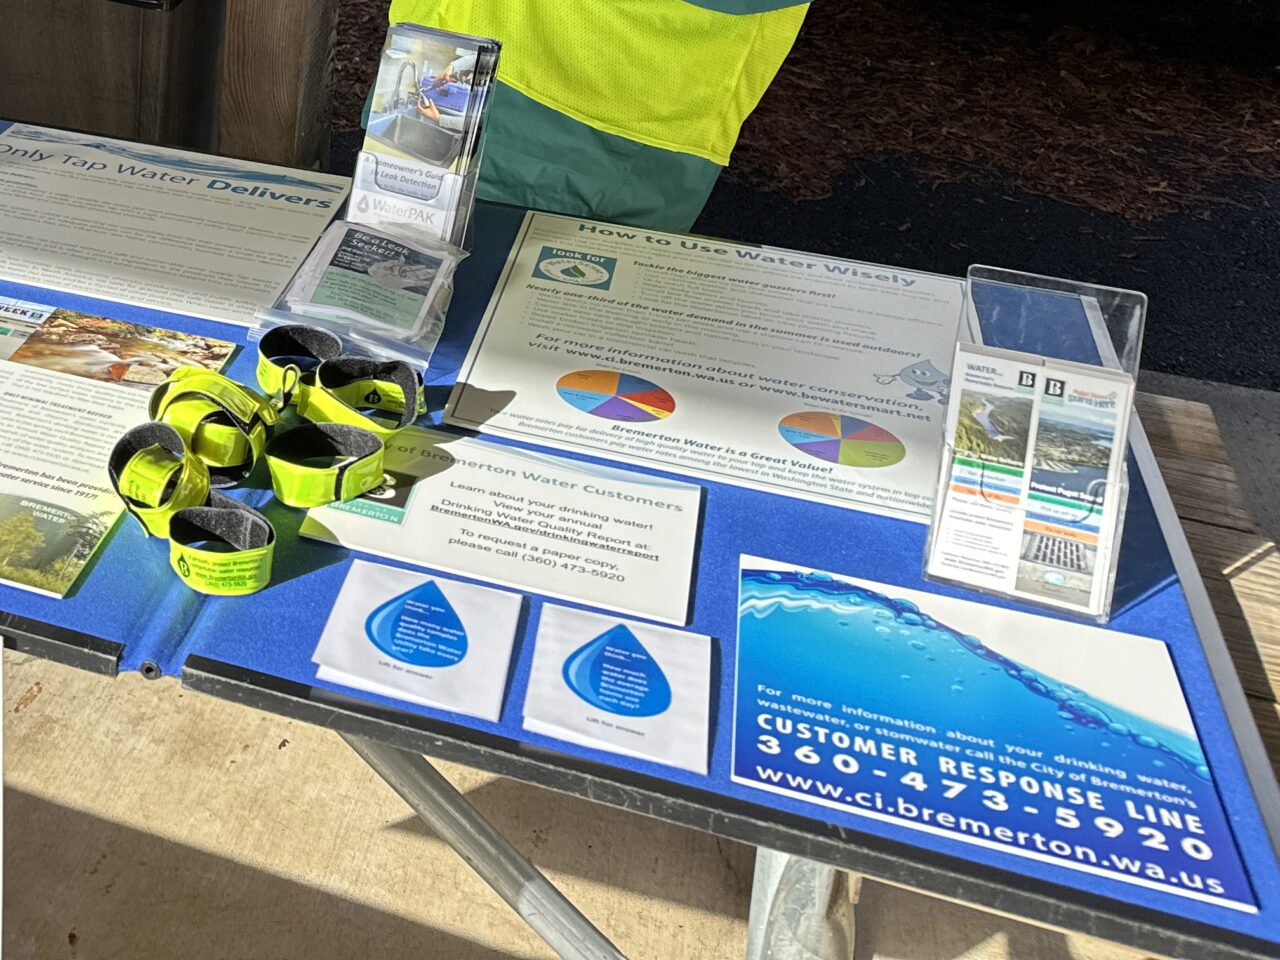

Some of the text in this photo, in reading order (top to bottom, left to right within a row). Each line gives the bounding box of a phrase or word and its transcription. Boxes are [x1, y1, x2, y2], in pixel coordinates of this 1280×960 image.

[62, 155, 107, 171] Tap
[117, 164, 200, 186] Water
[206, 180, 332, 209] Delivers
[381, 171, 398, 180] Leak
[400, 176, 436, 190] Detection
[373, 199, 435, 224] WaterPAK
[350, 239, 395, 256] Seeker!
[354, 232, 369, 241] Be
[382, 241, 410, 255] Leak
[552, 248, 606, 263] look for
[578, 224, 916, 287] How to Use Water Wisely
[529, 342, 931, 422] visit www.ci.bremerton.wa.us or www.bewatersmart.net
[536, 334, 924, 411] For more information about water conservation,
[611, 425, 681, 443] Bremerton
[684, 438, 723, 452] Water
[725, 448, 735, 456] is
[751, 453, 787, 465] Great
[791, 460, 834, 474] Value!
[20, 476, 50, 488] service
[51, 483, 72, 493] since
[75, 490, 98, 500] 1917!
[39, 471, 55, 480] has
[56, 474, 78, 486] been
[398, 445, 683, 512] of Bremerton Water Customers
[441, 499, 651, 550] Drinking Water Quality Report at:
[450, 480, 653, 531] Learn about your drinking water!
[493, 500, 603, 530] View your annual
[430, 505, 660, 561] BremertonWA.gov/drinkingwaterreport
[459, 528, 474, 537] To
[479, 532, 527, 550] request
[543, 548, 582, 563] paper
[585, 558, 619, 571] copy,
[448, 536, 625, 582] please call (360) 473-5920
[757, 684, 1192, 794] For more information about your drinking water,
[757, 698, 1197, 809] wastewater, or stomwater call the City of Bremerton's
[757, 713, 1206, 835] CUSTOMER RESPONSE LINE
[757, 735, 1214, 861] 360-473-5920
[756, 766, 1225, 894] www.ci.bremerton.wa.us
